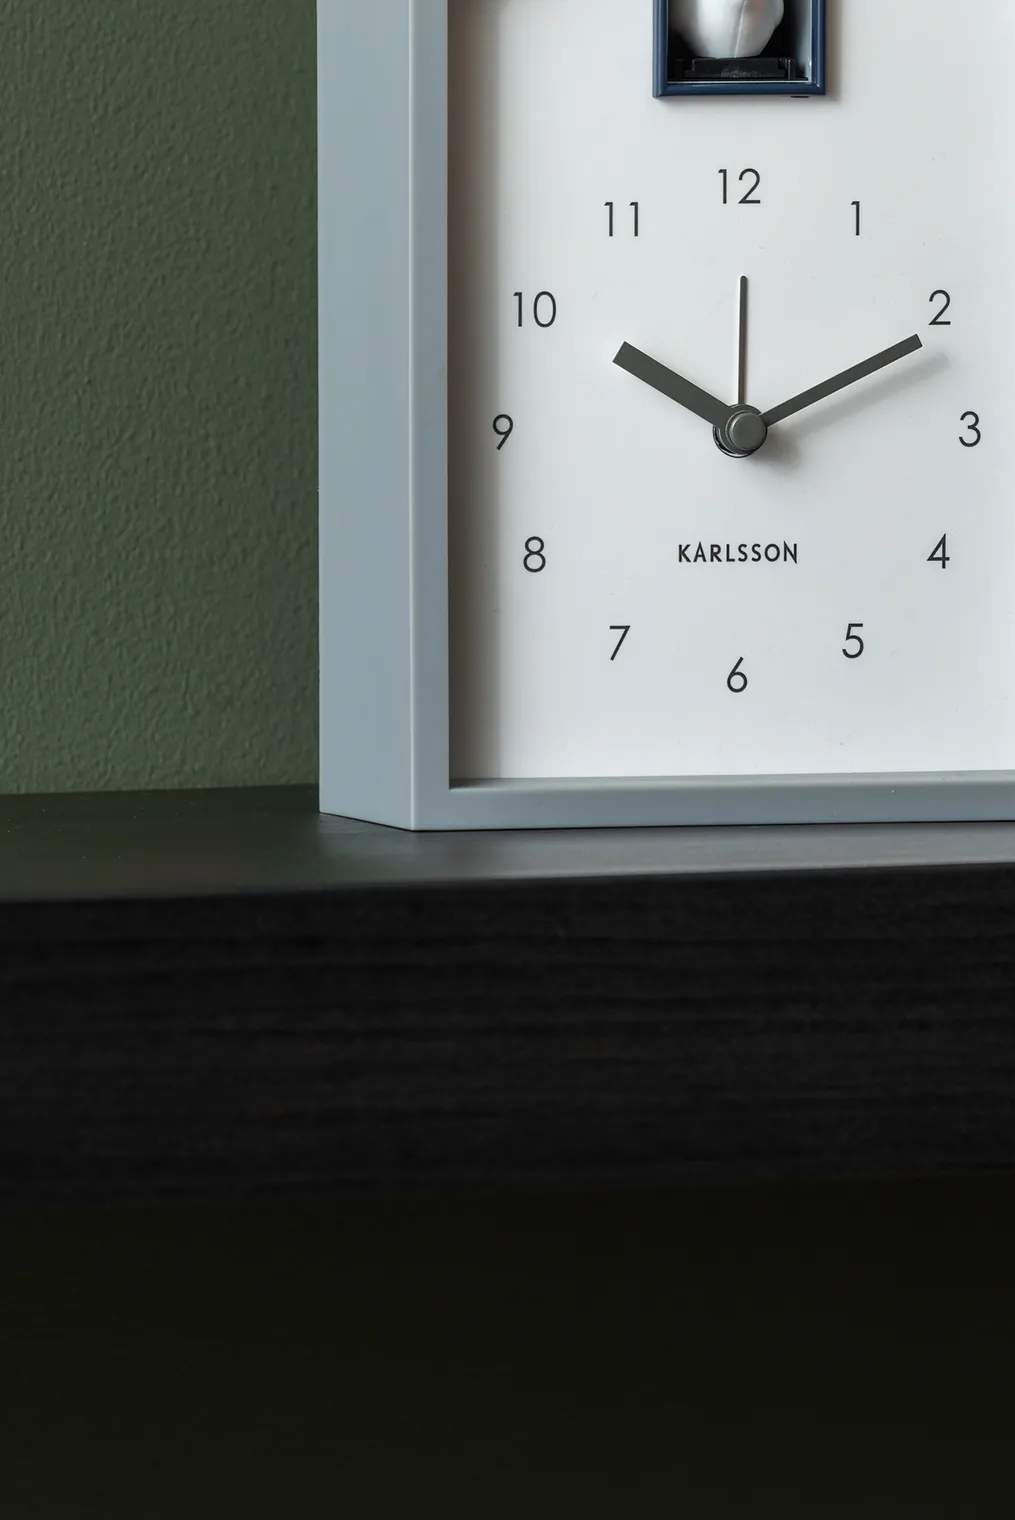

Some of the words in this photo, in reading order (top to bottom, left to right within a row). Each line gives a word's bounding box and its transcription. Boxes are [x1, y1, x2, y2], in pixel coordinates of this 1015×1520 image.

[719, 168, 760, 204] 12
[605, 202, 638, 236] 11
[851, 201, 860, 236] 1
[513, 291, 556, 327] 10
[929, 290, 951, 325] 2
[493, 414, 513, 450] 9
[959, 411, 981, 447] 3
[523, 536, 545, 572] 8
[679, 541, 797, 563] KARLSSON
[927, 534, 950, 569] 4
[610, 625, 630, 661] 7
[842, 623, 864, 658] 5
[727, 657, 747, 693] 6
